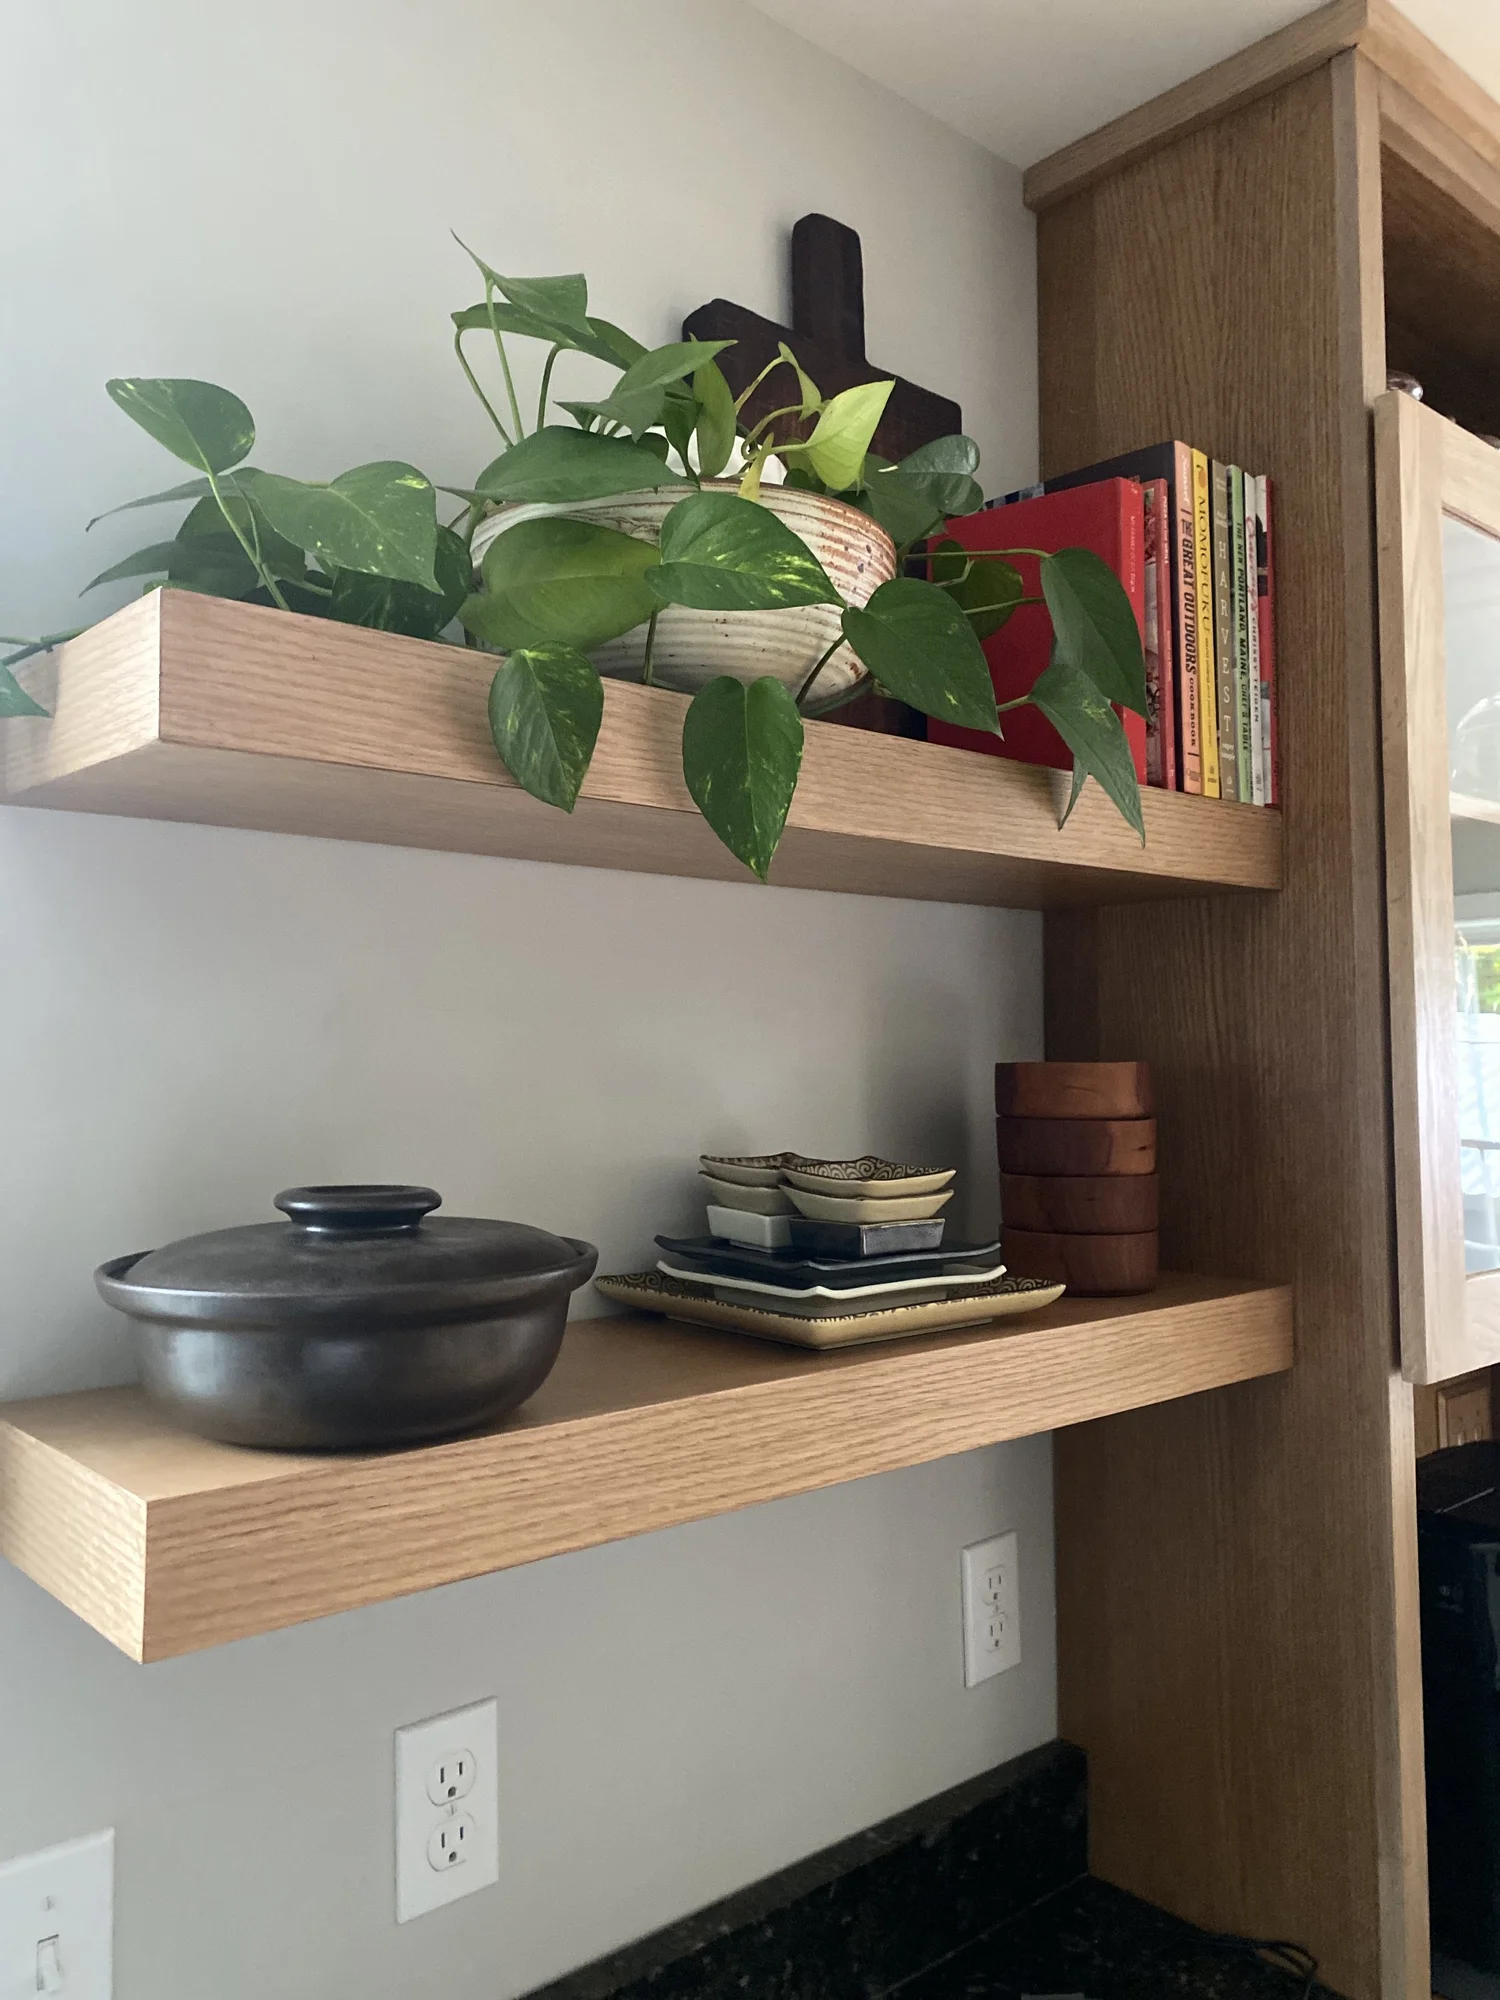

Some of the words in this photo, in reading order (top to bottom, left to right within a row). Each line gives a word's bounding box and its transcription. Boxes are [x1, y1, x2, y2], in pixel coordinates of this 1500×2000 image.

[1182, 538, 1195, 587] GREAT
[1199, 496, 1211, 632] MOMOFUKU
[1238, 567, 1246, 633] PORTLAND,
[1184, 592, 1197, 679] OUTDOORS
[1219, 541, 1231, 732] HARVEST
[1239, 638, 1247, 679] MAINE,
[1189, 677, 1197, 747] COOKBOOK
